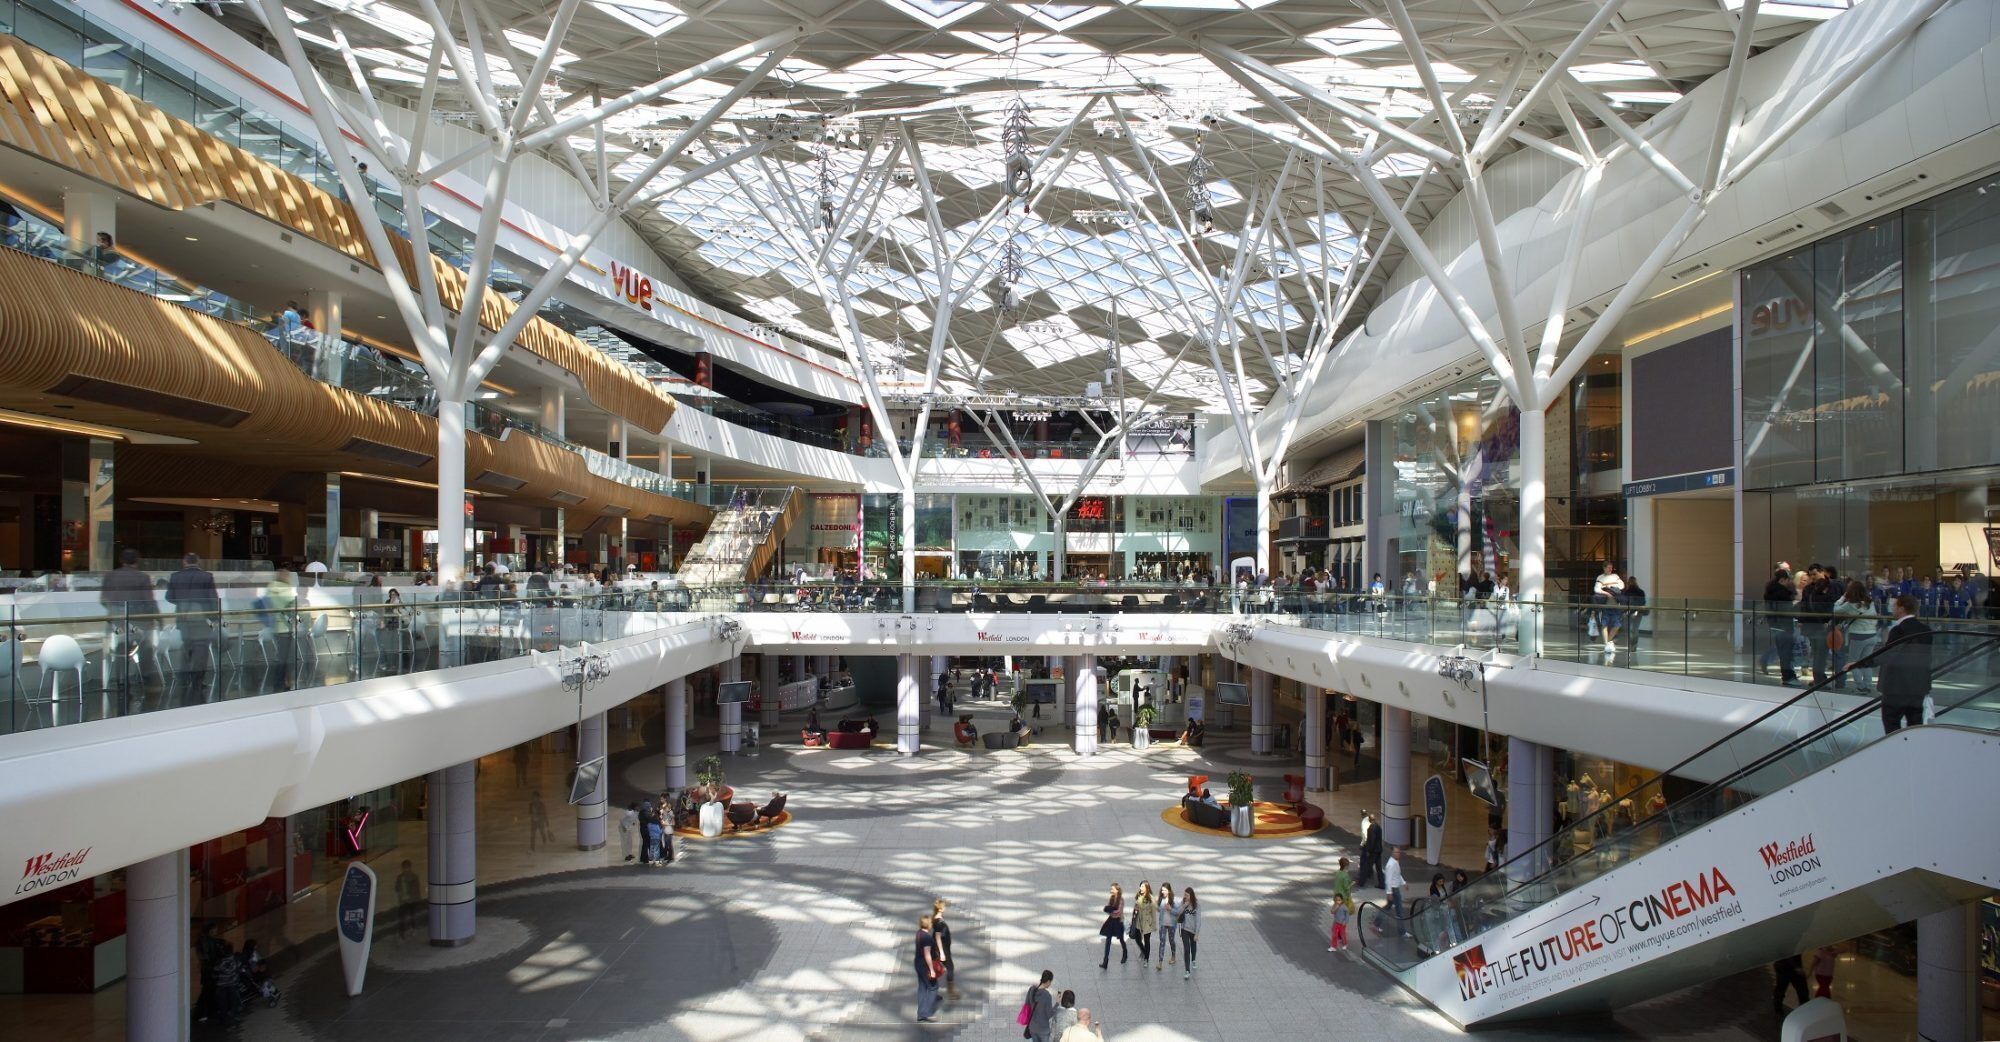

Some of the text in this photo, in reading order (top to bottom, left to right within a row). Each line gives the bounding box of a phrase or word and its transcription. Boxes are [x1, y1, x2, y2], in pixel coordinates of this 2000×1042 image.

[1625, 486, 1636, 494] LIFT
[1636, 484, 1652, 494] LOBBY
[978, 632, 1002, 642] Westfield
[22, 846, 94, 880] Westfield
[1758, 832, 1816, 870] Westfield
[15, 867, 79, 894] LONDON
[1770, 856, 1821, 885] LONDON
[1487, 953, 1523, 988] THE
[1520, 920, 1603, 976] FUTURE
[1600, 906, 1626, 944] OF
[1629, 866, 1736, 931] CINEMA
[1627, 900, 1742, 954] www.myvue.com/westfield
